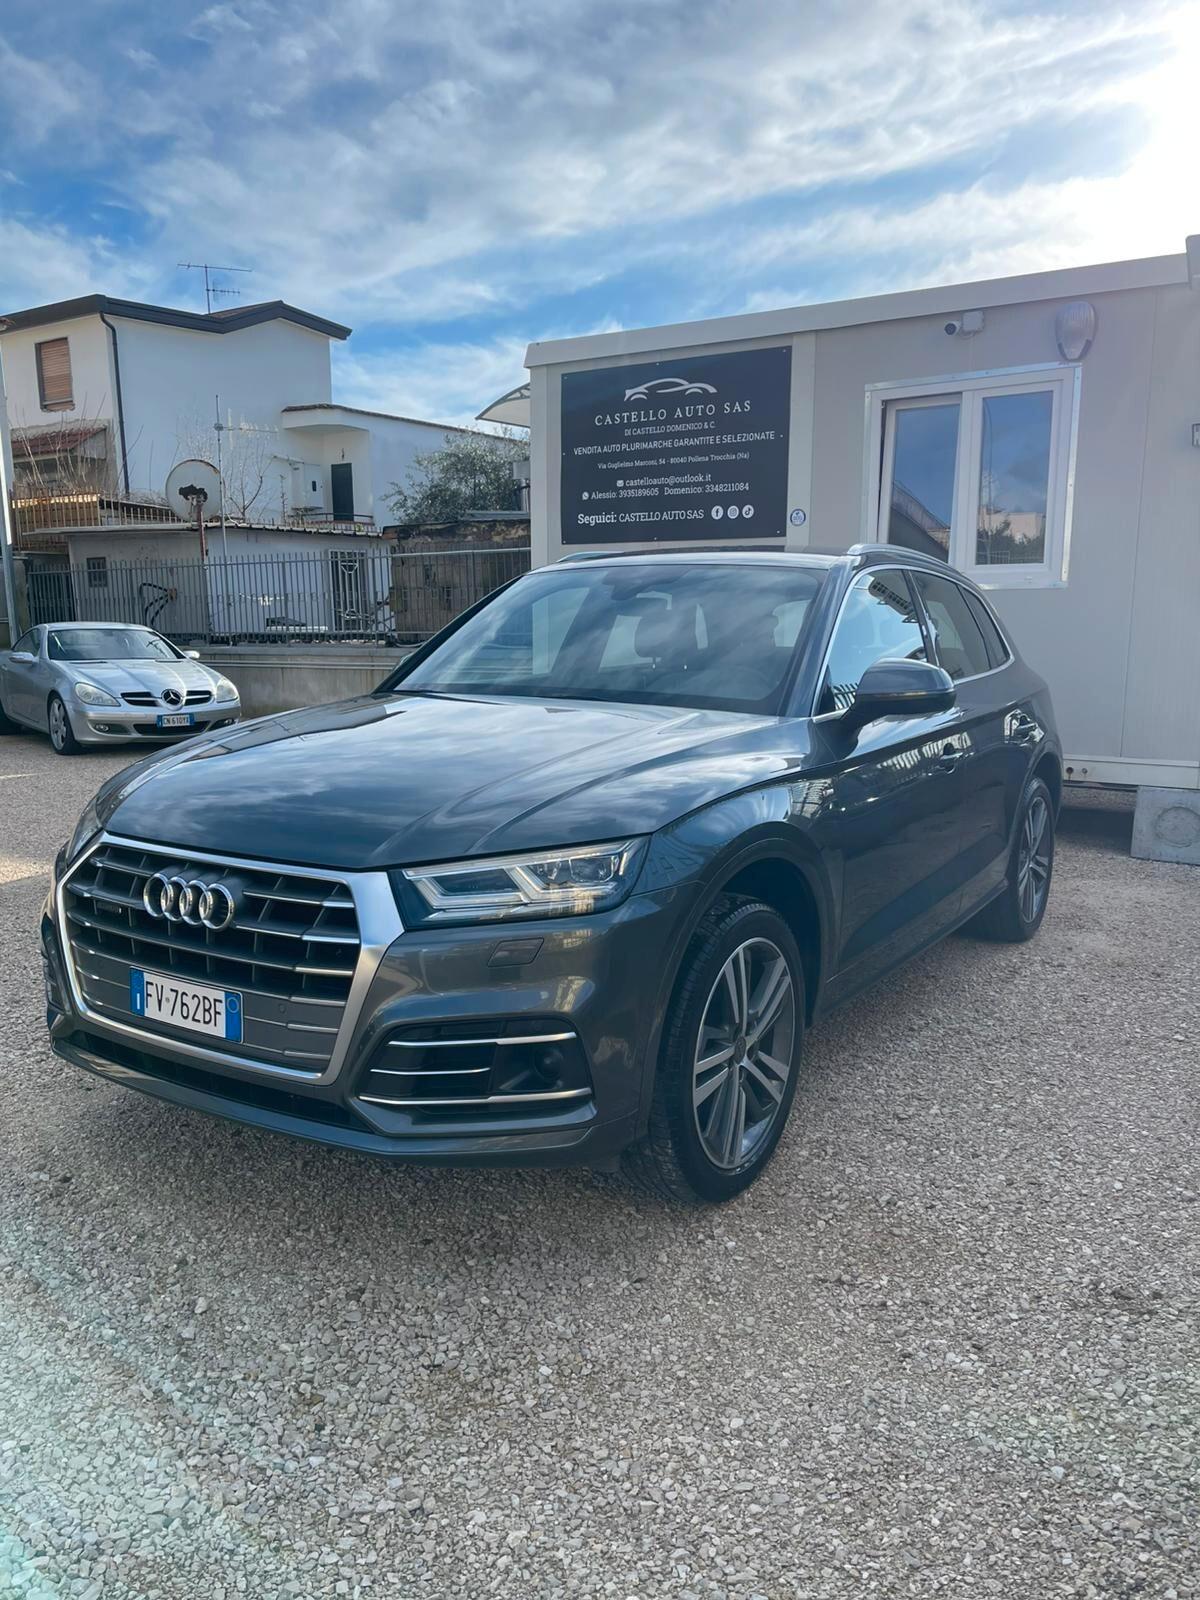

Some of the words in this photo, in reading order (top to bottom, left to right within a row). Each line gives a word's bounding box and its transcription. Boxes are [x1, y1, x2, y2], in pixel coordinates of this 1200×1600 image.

[594, 409, 667, 426] CASTELLO
[674, 404, 716, 418] AUTO
[724, 400, 752, 414] SAS
[624, 428, 632, 436] DI
[632, 426, 666, 436] CASTELLO
[666, 422, 702, 432] DOMENICO
[704, 421, 709, 429] &
[573, 445, 602, 455] VENDITA
[603, 443, 621, 453] AUTO
[622, 439, 673, 451] PLURIMARCHE
[673, 435, 714, 447] GARANTITE
[716, 435, 721, 444] E
[722, 431, 775, 443] SELEZIONATE
[607, 461, 634, 470] Guglielmo
[688, 455, 709, 463] Pollena
[710, 453, 736, 461] Trocchia
[736, 452, 750, 460] (Na)
[625, 473, 712, 487] castelloauto@outlook.it
[590, 490, 618, 500] Alessio:
[618, 487, 659, 498] 3935189605
[664, 485, 704, 495] Domenico:
[705, 482, 749, 493] 3348211084
[577, 511, 617, 527] Seguici:
[619, 511, 661, 522] CASTELLO
[662, 510, 686, 521] AUTO
[687, 509, 705, 519] SAS
